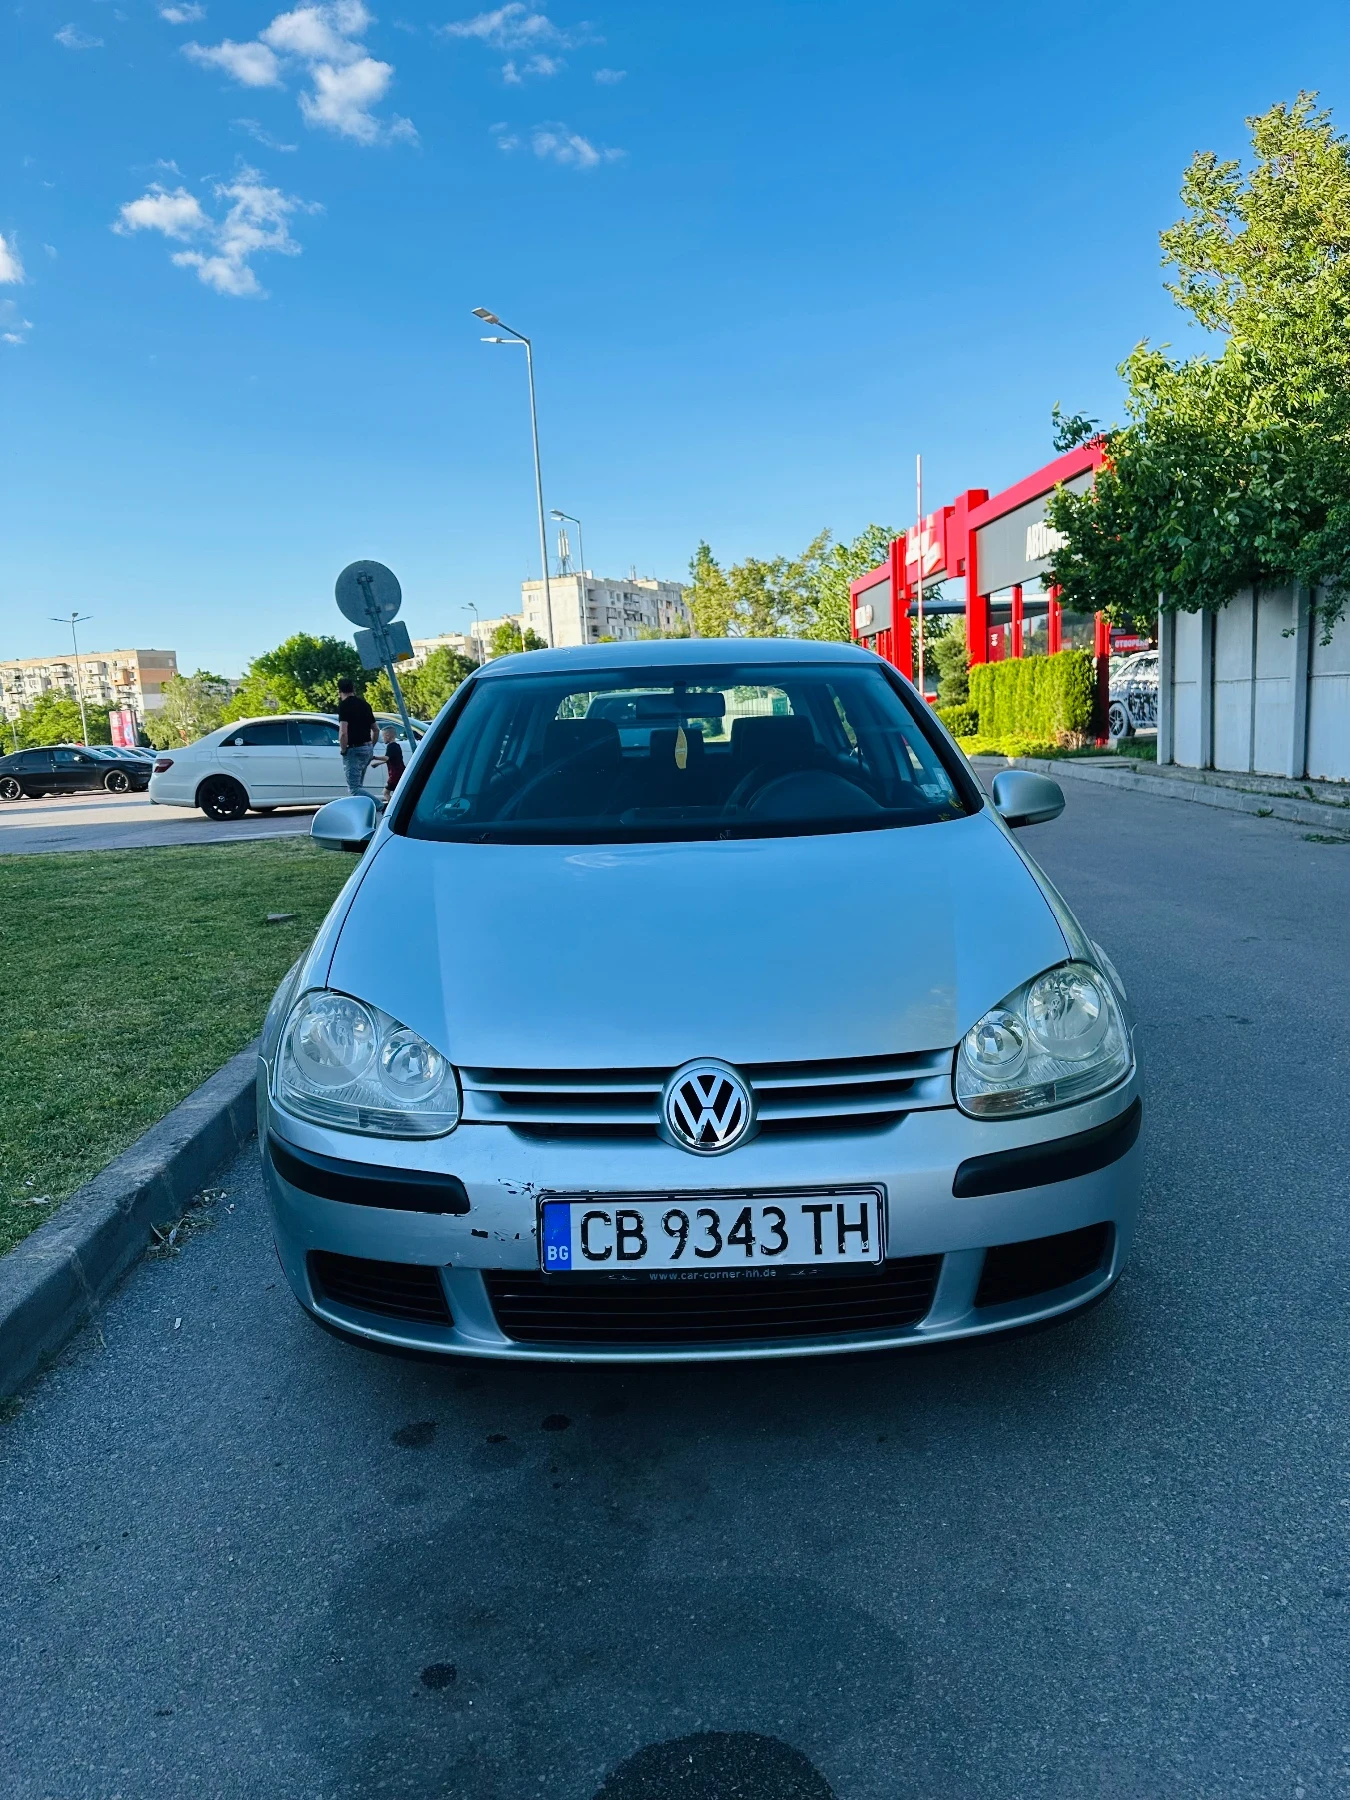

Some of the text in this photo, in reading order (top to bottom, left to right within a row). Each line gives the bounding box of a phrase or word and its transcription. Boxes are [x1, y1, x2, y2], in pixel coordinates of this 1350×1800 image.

[580, 1202, 870, 1261] CB 9343 TH
[547, 1245, 569, 1261] BG
